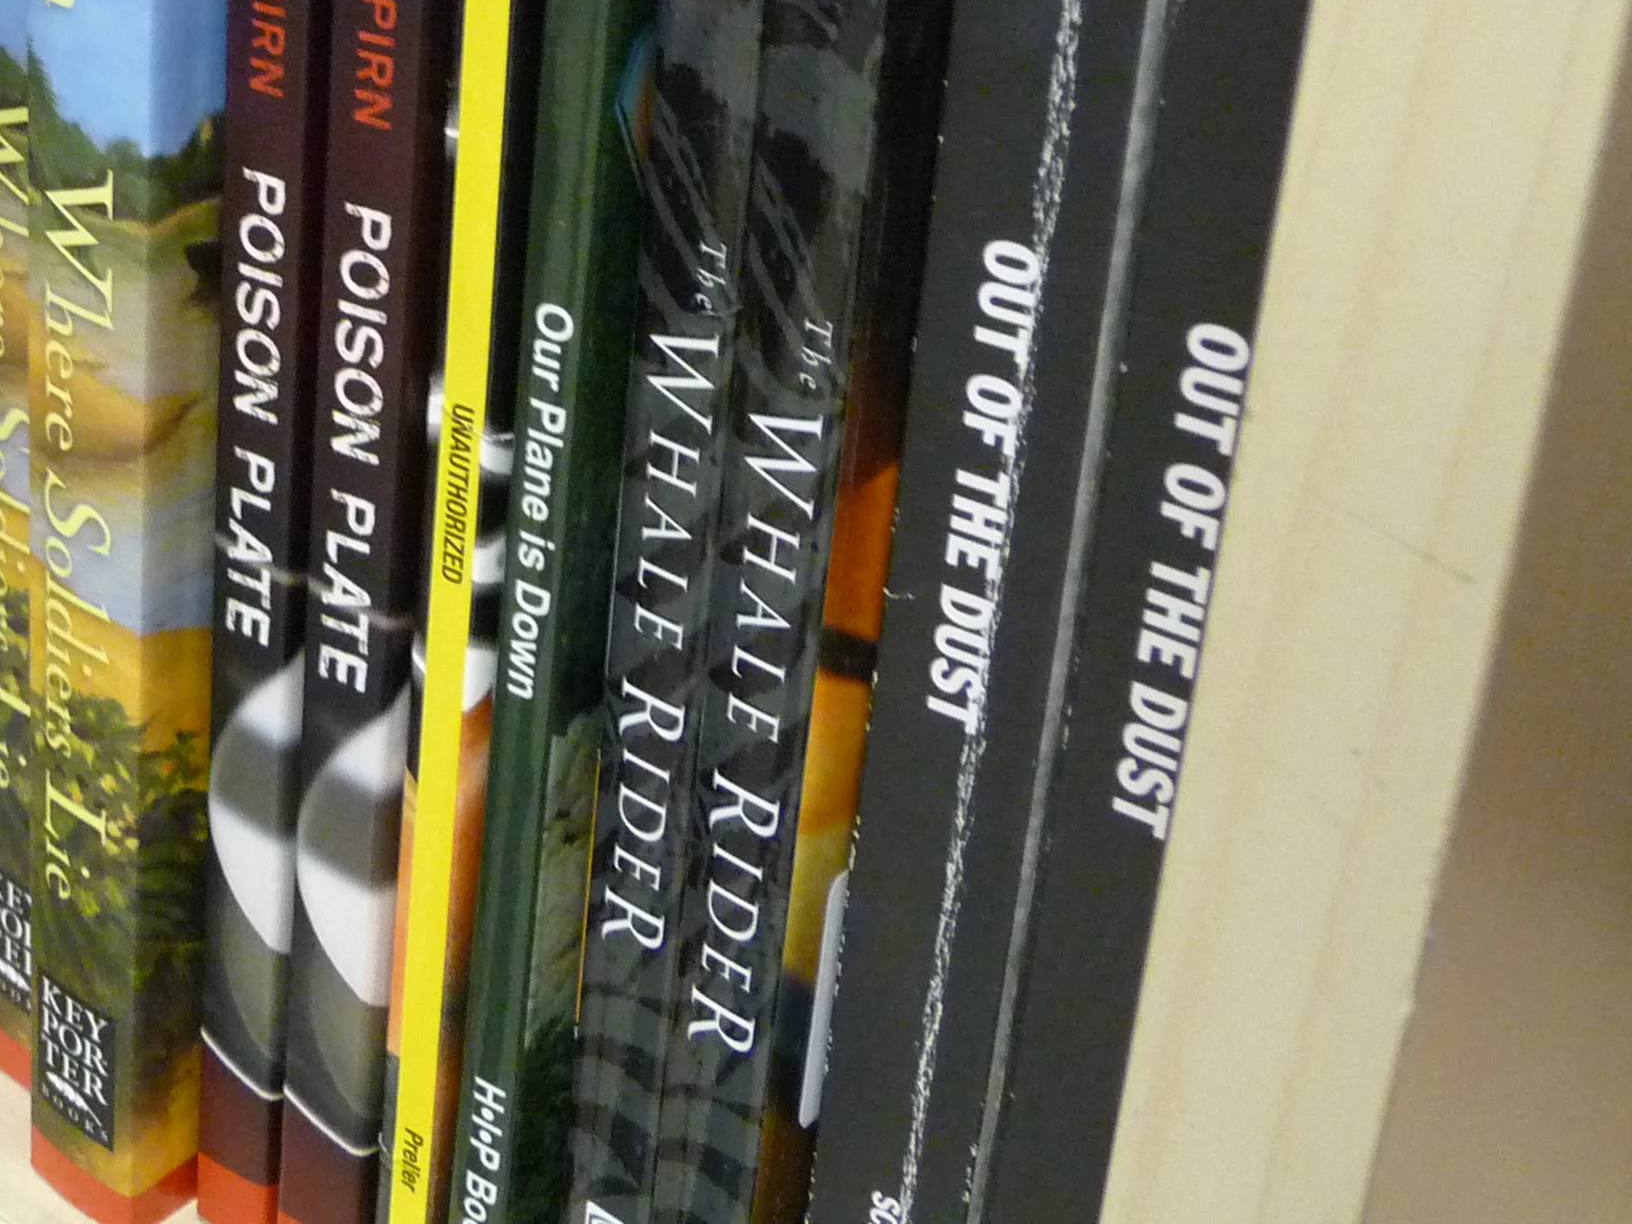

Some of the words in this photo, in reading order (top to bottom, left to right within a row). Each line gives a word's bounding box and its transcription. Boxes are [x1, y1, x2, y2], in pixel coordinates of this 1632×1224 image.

[44, 168, 115, 454] Where
[232, 166, 288, 428] POISON
[330, 201, 394, 467] POISON
[694, 241, 728, 318] The
[975, 239, 1040, 366] OUT
[532, 302, 575, 393] Our
[798, 318, 834, 391] The
[1173, 321, 1251, 457] OUT
[521, 402, 568, 523] Plane
[963, 373, 1024, 459] OF
[224, 445, 277, 648] PLATE
[441, 403, 477, 586] UNAUTHORIZED
[518, 529, 556, 573] is
[633, 331, 721, 652] WHALE
[945, 468, 1013, 589] THE
[1159, 463, 1227, 550] OF
[44, 468, 112, 759] Soldiers
[318, 487, 376, 695] PLATE
[506, 582, 552, 702] Down
[725, 411, 826, 745] WHALE
[1136, 561, 1213, 680] THE
[926, 583, 994, 735] DUST
[601, 678, 687, 952] RIDER
[1111, 680, 1191, 841] DUST
[44, 769, 109, 901] Lie
[687, 767, 781, 1056] RIDER
[41, 975, 109, 1044] KEY
[41, 1003, 109, 1078] POR
[41, 1032, 109, 1107] TER
